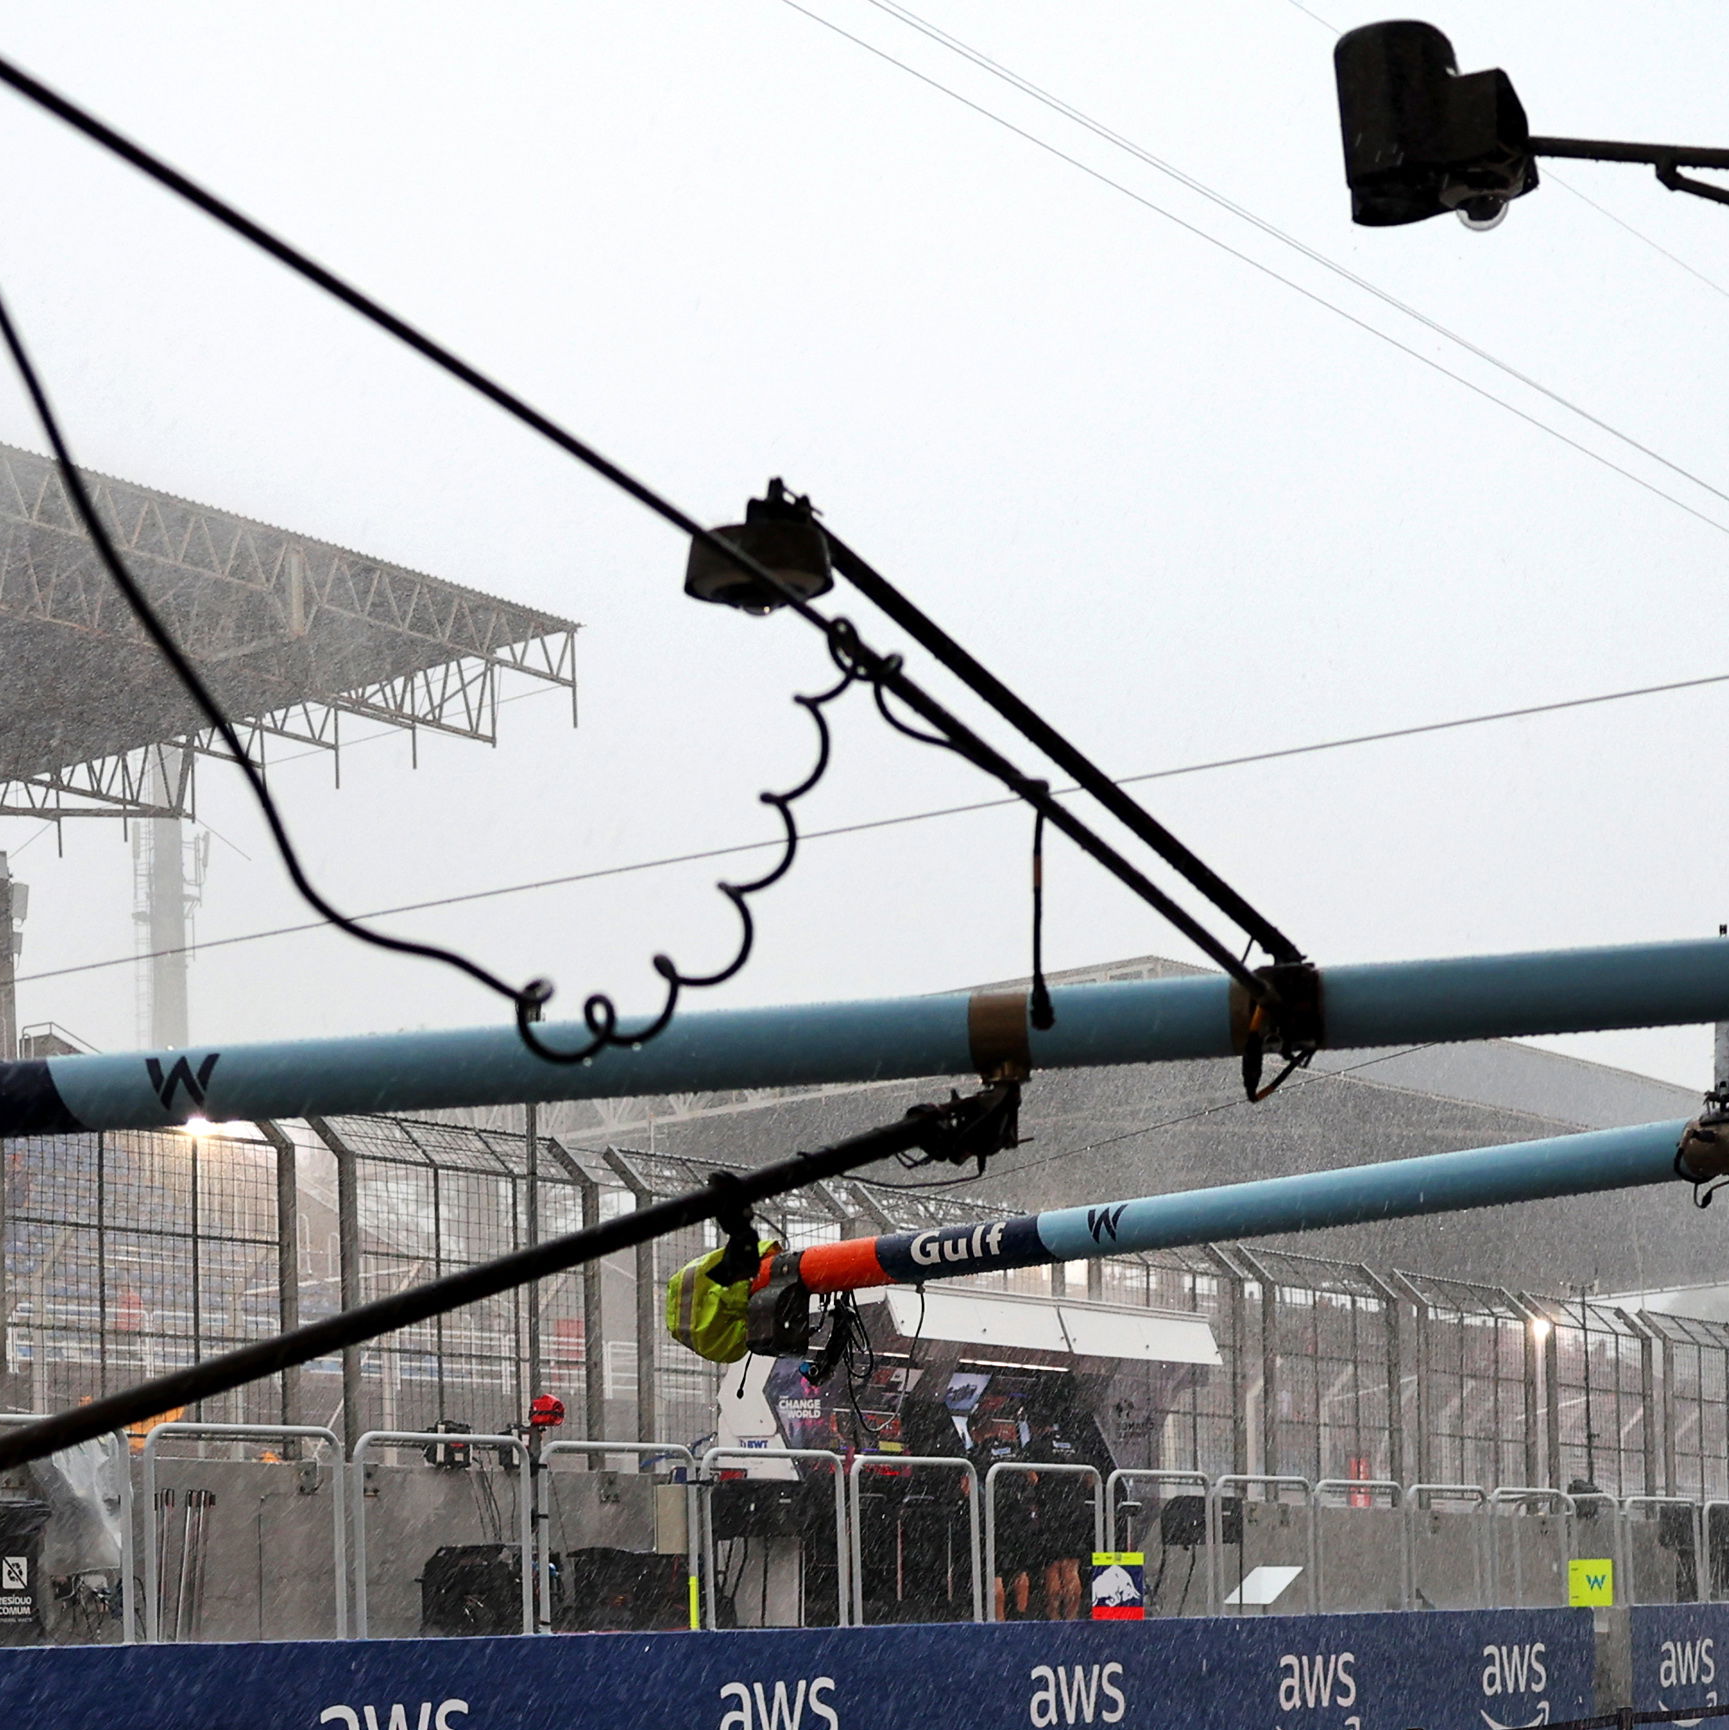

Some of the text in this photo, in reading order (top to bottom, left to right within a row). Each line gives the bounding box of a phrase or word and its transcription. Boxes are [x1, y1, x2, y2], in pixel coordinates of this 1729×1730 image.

[145, 1052, 221, 1111] W
[910, 1221, 1006, 1266] Gulf
[1087, 1203, 1129, 1245] W
[778, 1399, 821, 1410] CHANGE
[1279, 1651, 1357, 1710] aws
[1482, 1641, 1547, 1696] aws
[1659, 1637, 1715, 1689] aws
[1029, 1661, 1126, 1729] aws
